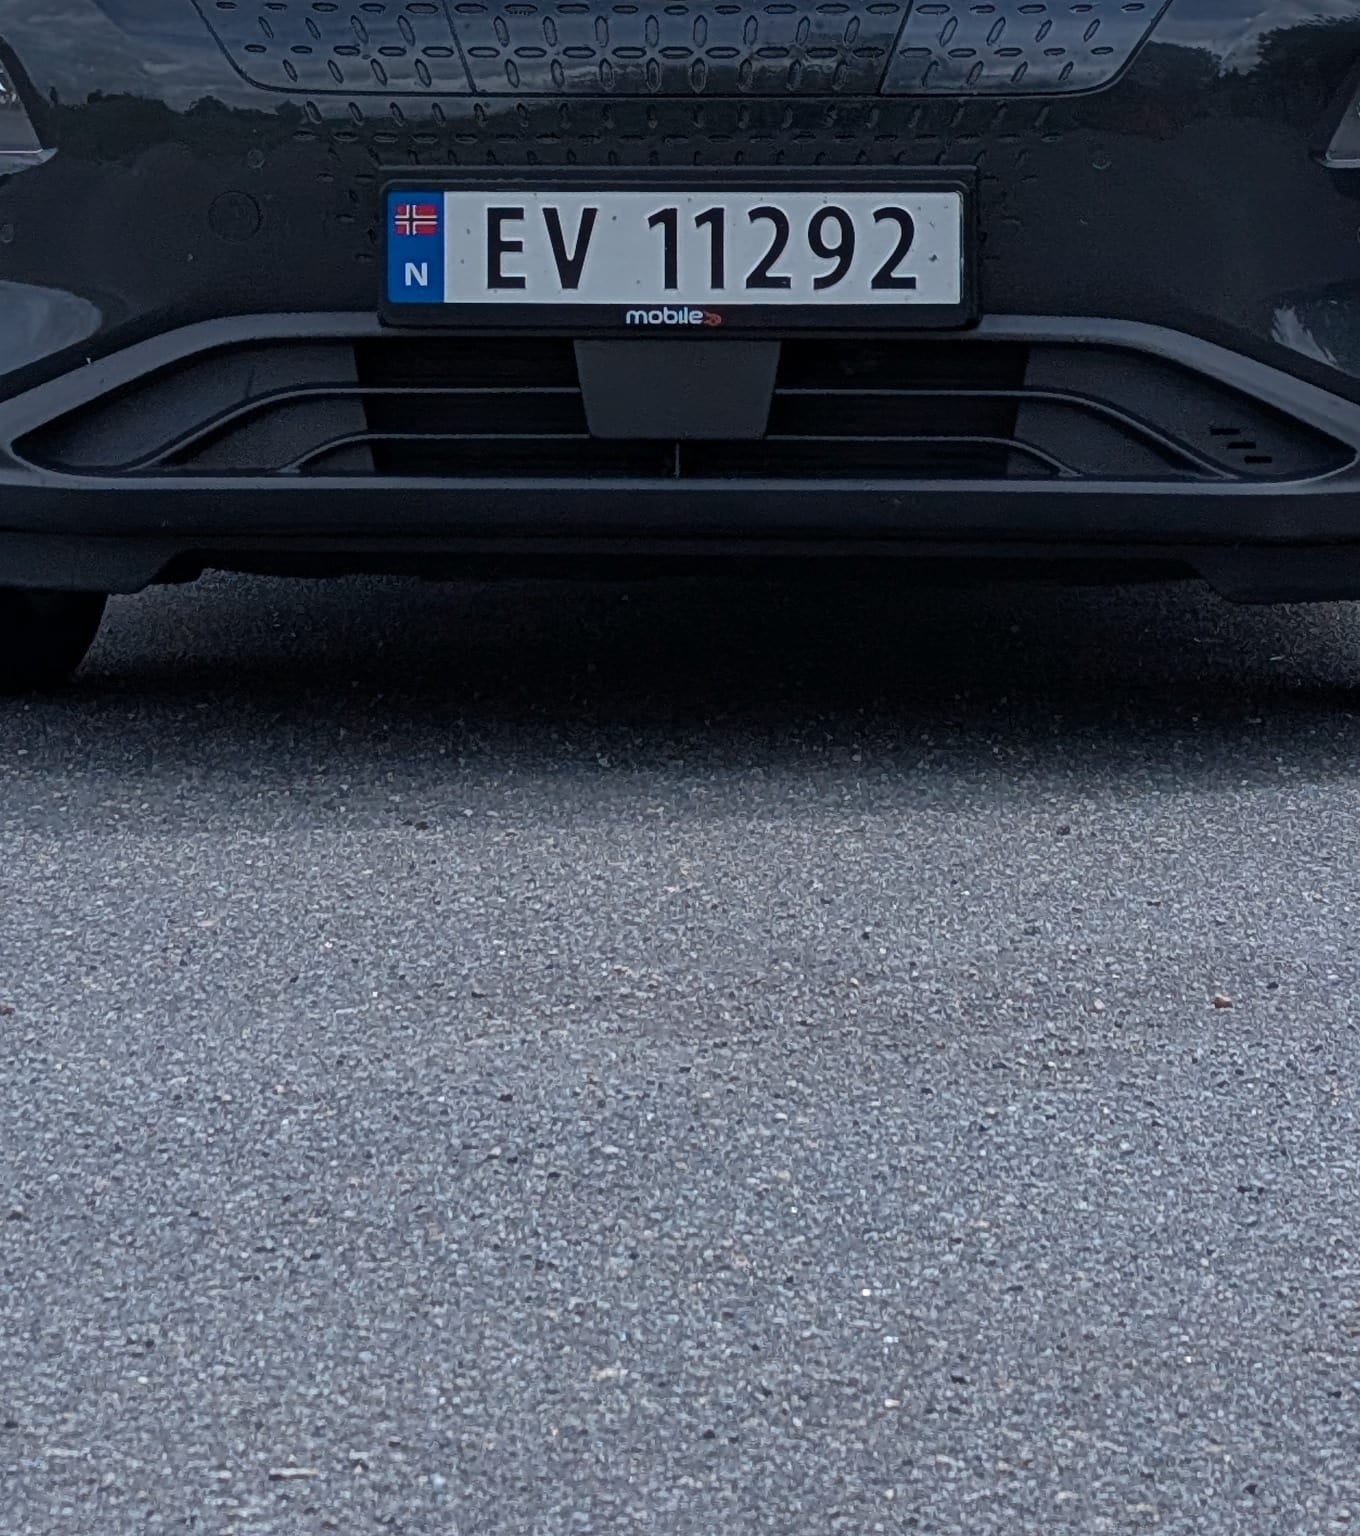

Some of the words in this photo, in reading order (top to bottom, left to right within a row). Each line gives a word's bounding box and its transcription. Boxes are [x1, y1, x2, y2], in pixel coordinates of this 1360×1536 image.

[404, 262, 428, 287] N
[486, 206, 598, 290] EV
[648, 206, 918, 290] 11292
